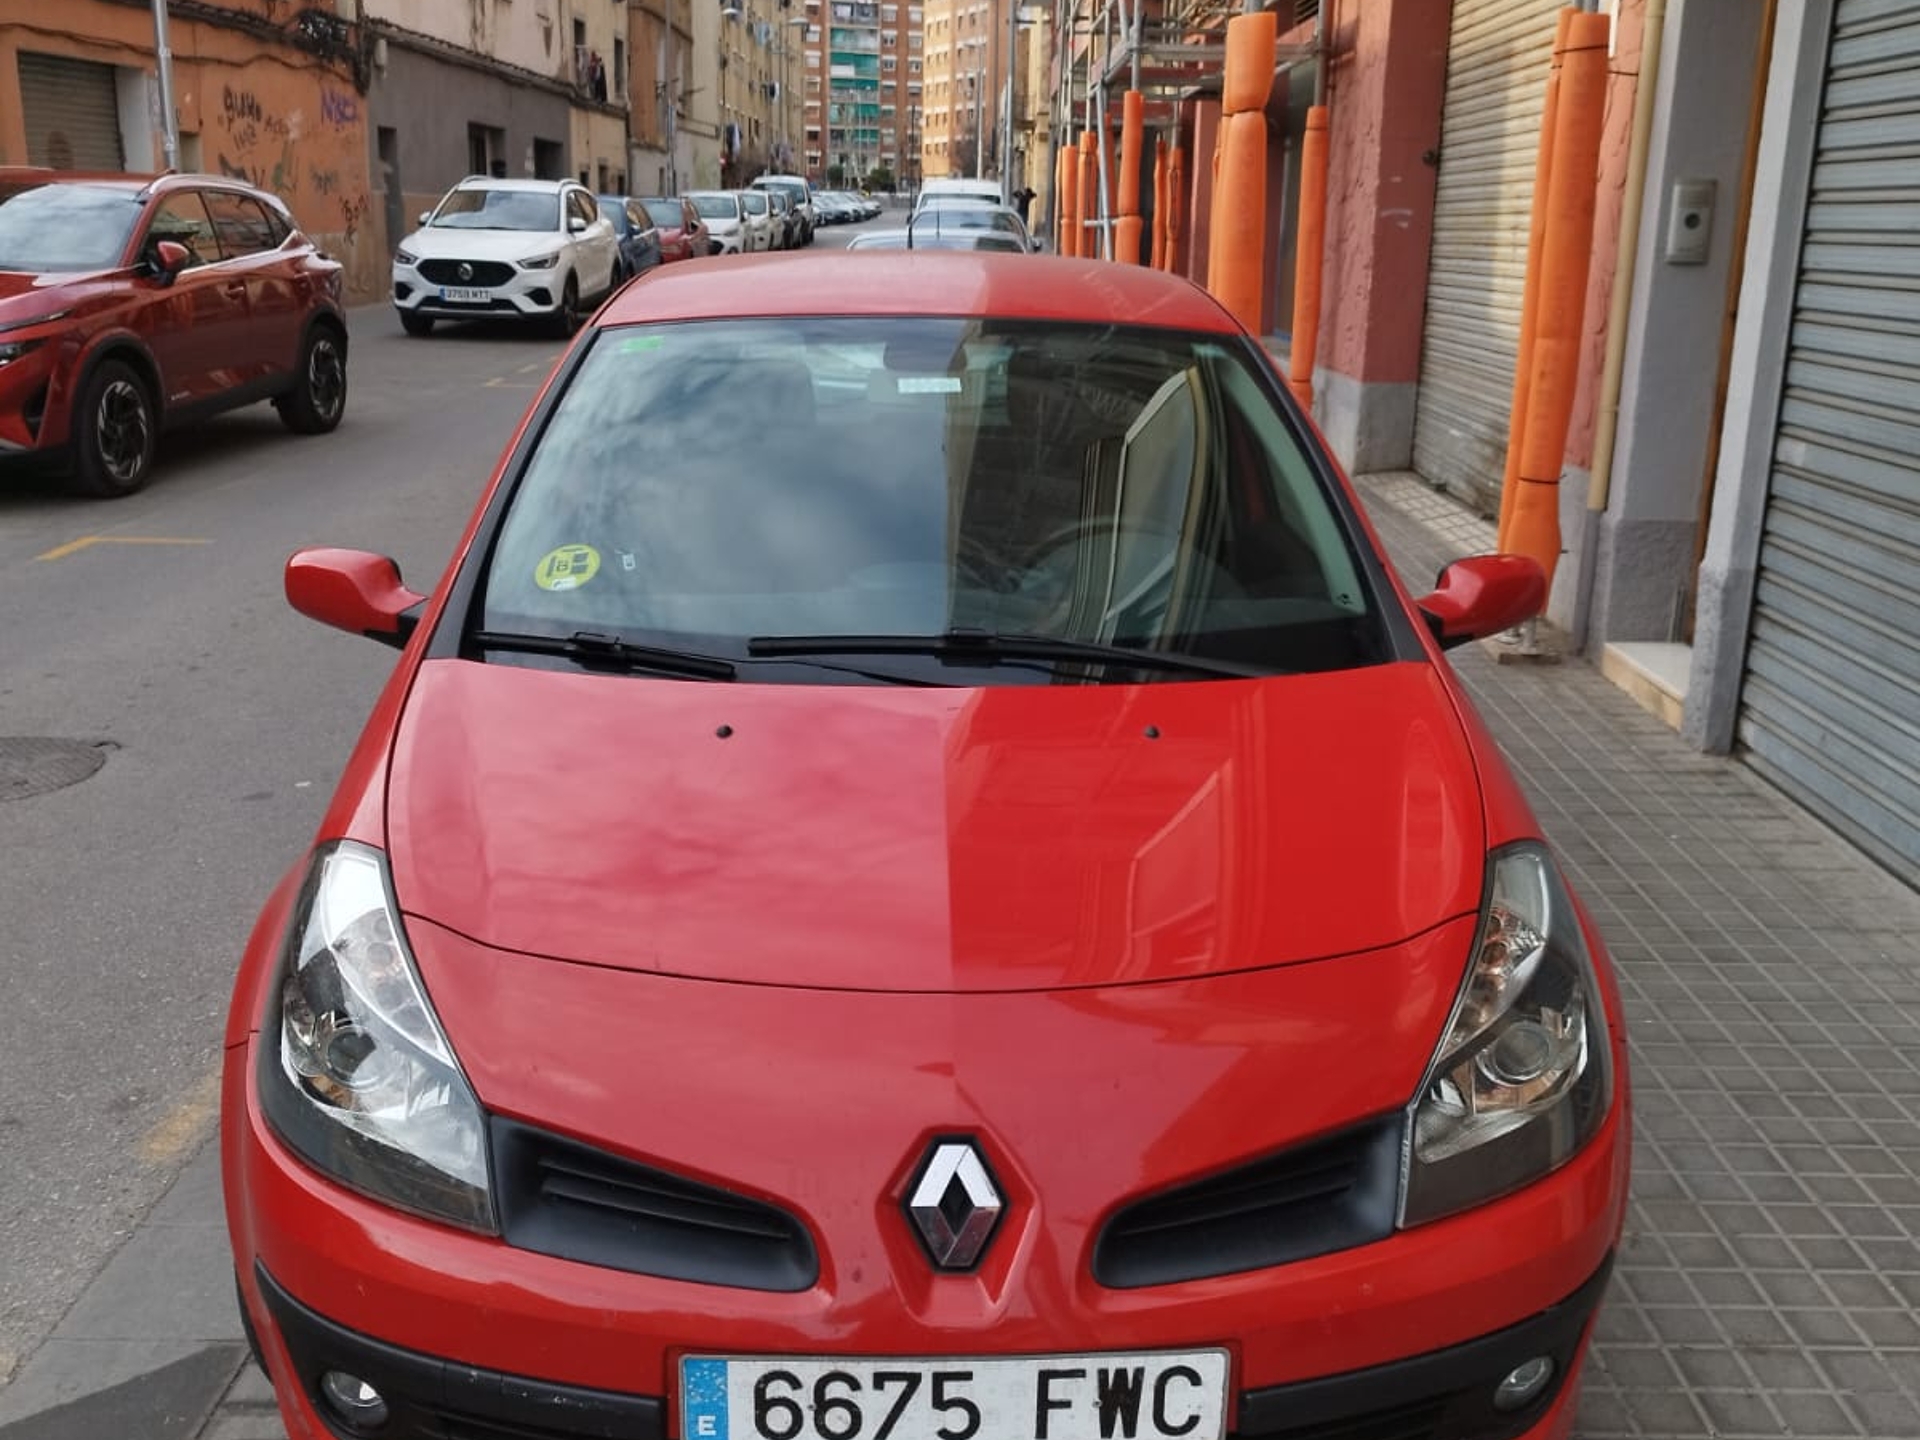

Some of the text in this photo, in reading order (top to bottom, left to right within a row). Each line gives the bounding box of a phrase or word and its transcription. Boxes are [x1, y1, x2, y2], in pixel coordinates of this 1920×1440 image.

[697, 1415, 717, 1436] E
[754, 1365, 1203, 1440] 6675 FWC
